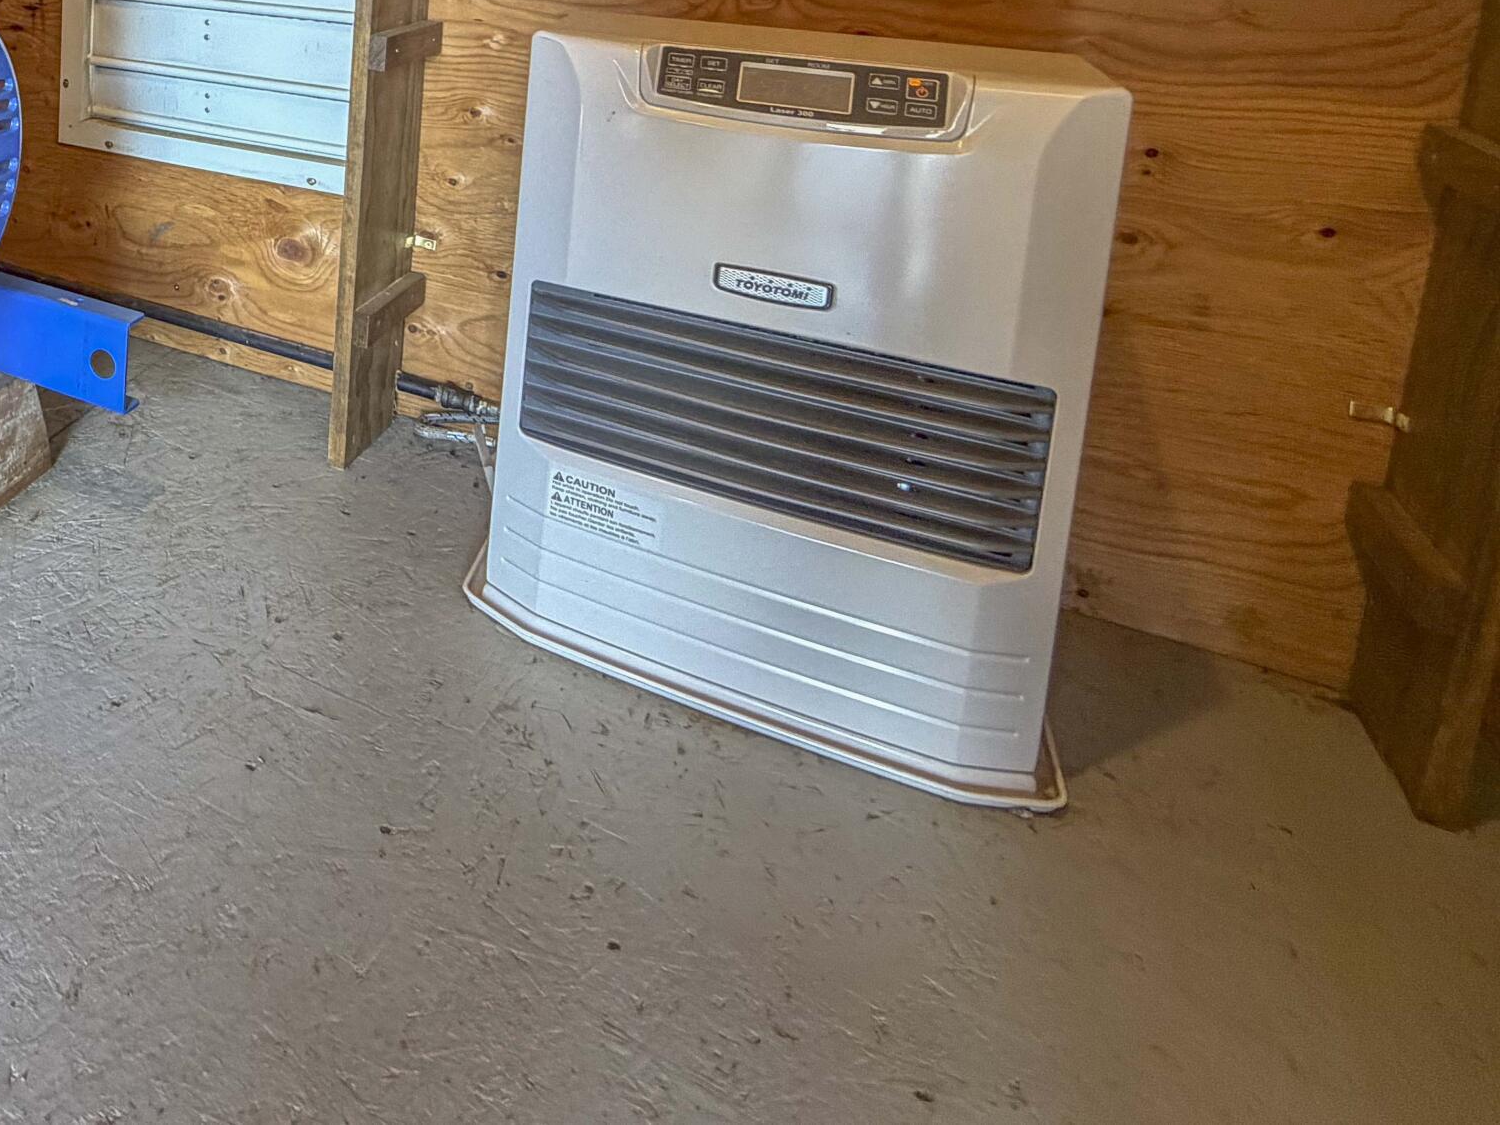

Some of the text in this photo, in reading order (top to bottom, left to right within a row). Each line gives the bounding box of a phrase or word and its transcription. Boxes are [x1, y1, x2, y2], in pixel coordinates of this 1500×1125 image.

[699, 82, 723, 90] CLEAR
[769, 106, 795, 115] Laser
[909, 106, 933, 115] AUTO
[735, 278, 810, 301] TOYOTOMI
[565, 475, 616, 498] CAUTION
[563, 495, 614, 518] ATTENTION
